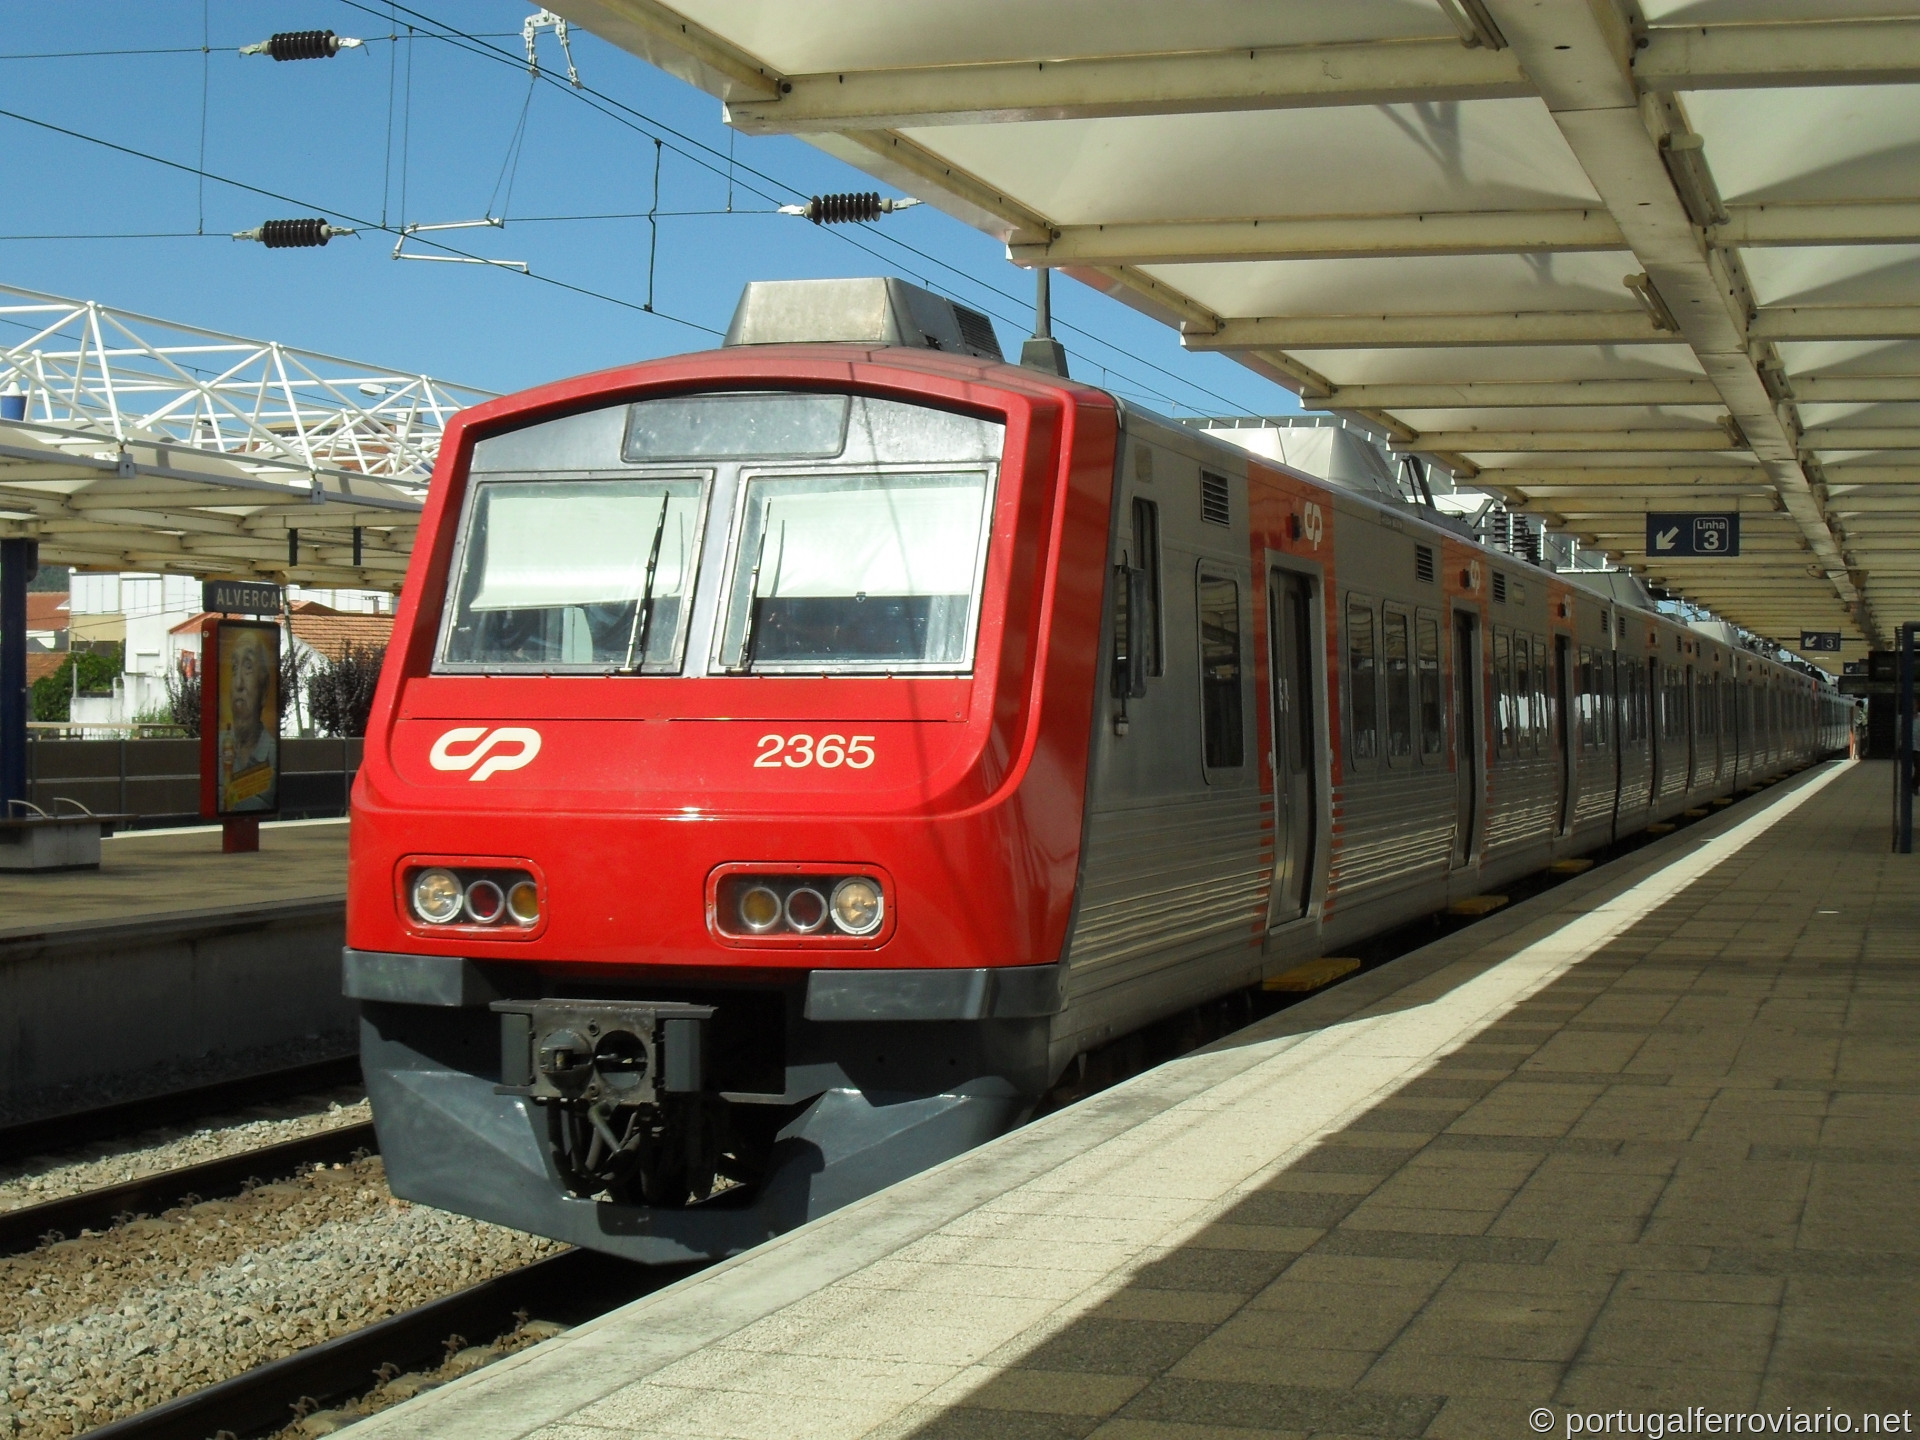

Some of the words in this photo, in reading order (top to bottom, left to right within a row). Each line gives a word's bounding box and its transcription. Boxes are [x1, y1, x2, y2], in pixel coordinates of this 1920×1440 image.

[1696, 519, 1726, 530] Linha
[1703, 530, 1719, 550] 3
[216, 587, 279, 609] ALVERCA
[1826, 639, 1834, 649] 3
[753, 734, 876, 769] 2365
